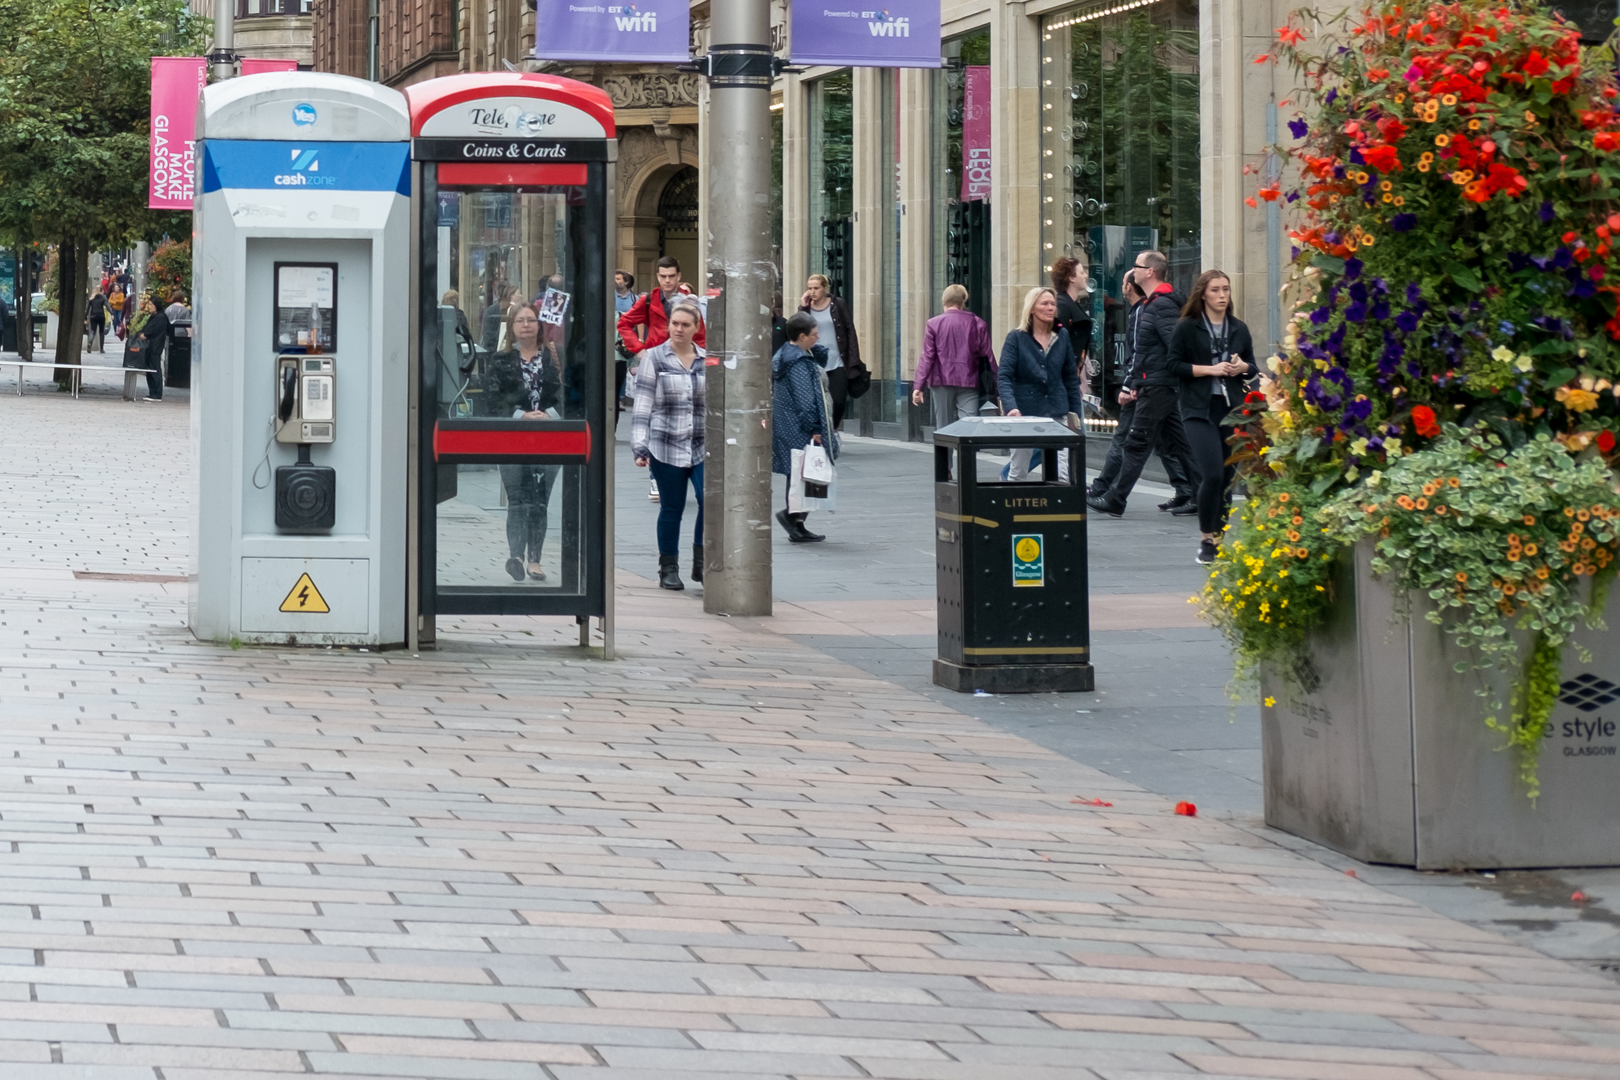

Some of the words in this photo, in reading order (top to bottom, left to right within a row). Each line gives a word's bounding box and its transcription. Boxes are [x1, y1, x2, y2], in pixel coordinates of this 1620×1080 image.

[569, 5, 597, 13] Powered
[823, 10, 850, 18] Powered
[615, 12, 657, 32] wifi
[868, 17, 909, 37] wifi
[294, 109, 315, 122] Yes
[153, 115, 169, 200] GLASGOW
[463, 143, 504, 158] Coins
[506, 143, 520, 158] &
[523, 143, 567, 158] Cards
[168, 153, 183, 200] MAKE
[183, 140, 196, 200] PEOPLE
[274, 173, 336, 185] cashzone
[541, 313, 560, 323] MILK
[1005, 498, 1048, 508] LITTER
[1563, 716, 1616, 742] style
[1563, 746, 1617, 757] GLASGOW
